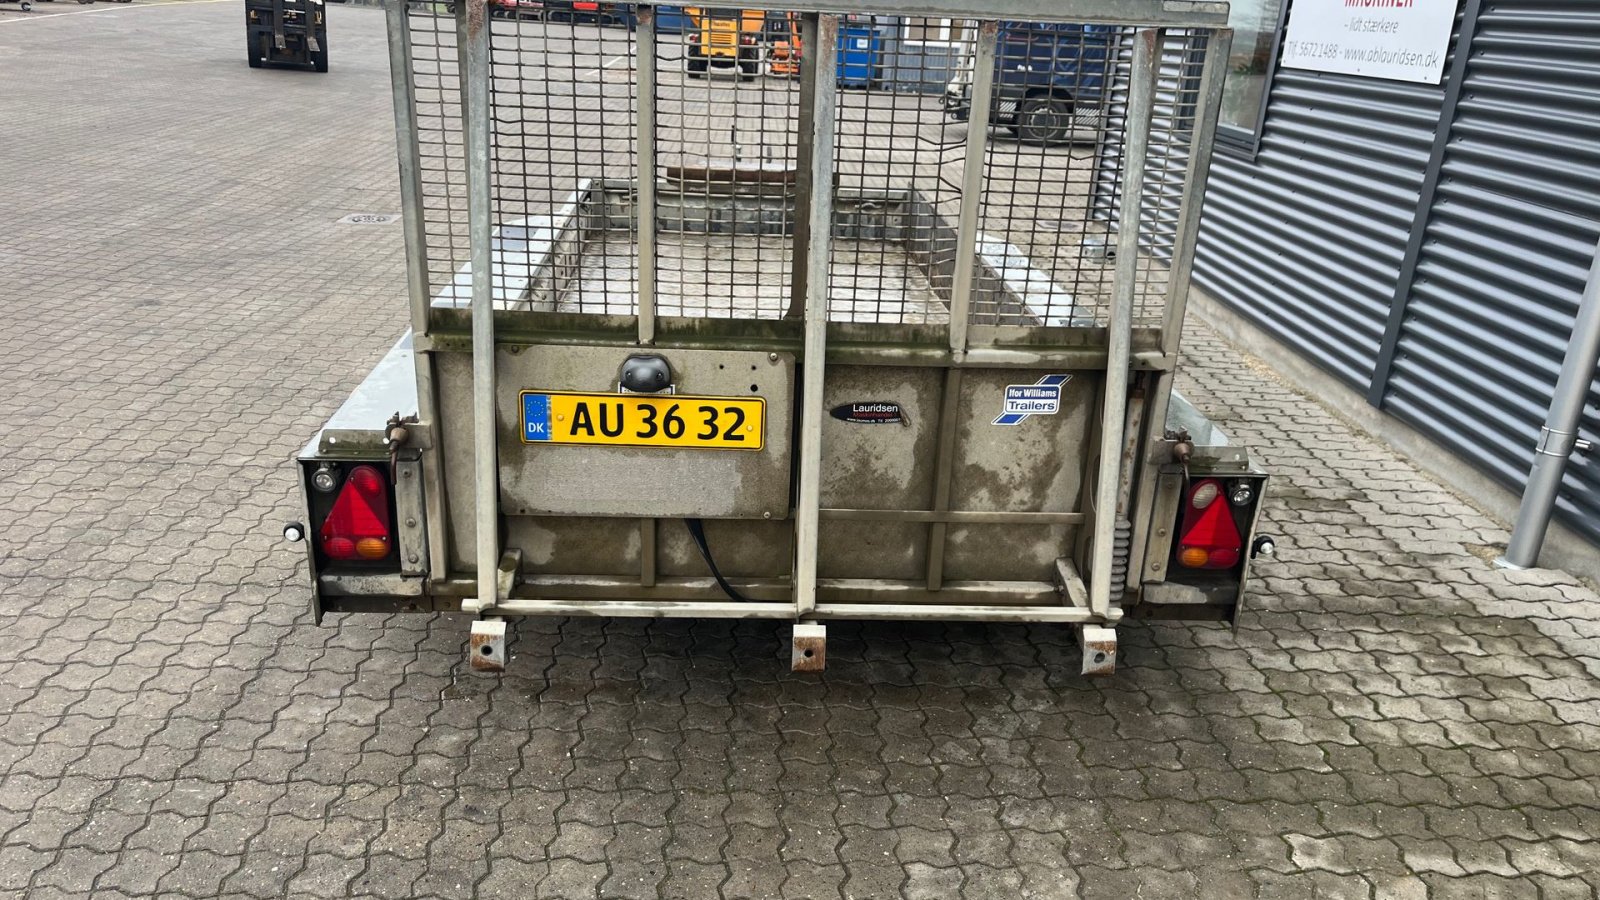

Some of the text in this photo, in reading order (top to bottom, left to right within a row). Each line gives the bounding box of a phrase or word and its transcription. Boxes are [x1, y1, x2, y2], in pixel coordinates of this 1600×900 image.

[1362, 18, 1399, 33] stærkere
[1343, 46, 1439, 69] www.ablauridsen.dk
[1023, 388, 1057, 398] Williams
[852, 403, 898, 412] Lauridsen
[1008, 400, 1056, 410] Trailers
[527, 421, 545, 434] DK
[569, 401, 746, 441] AU 36 32
